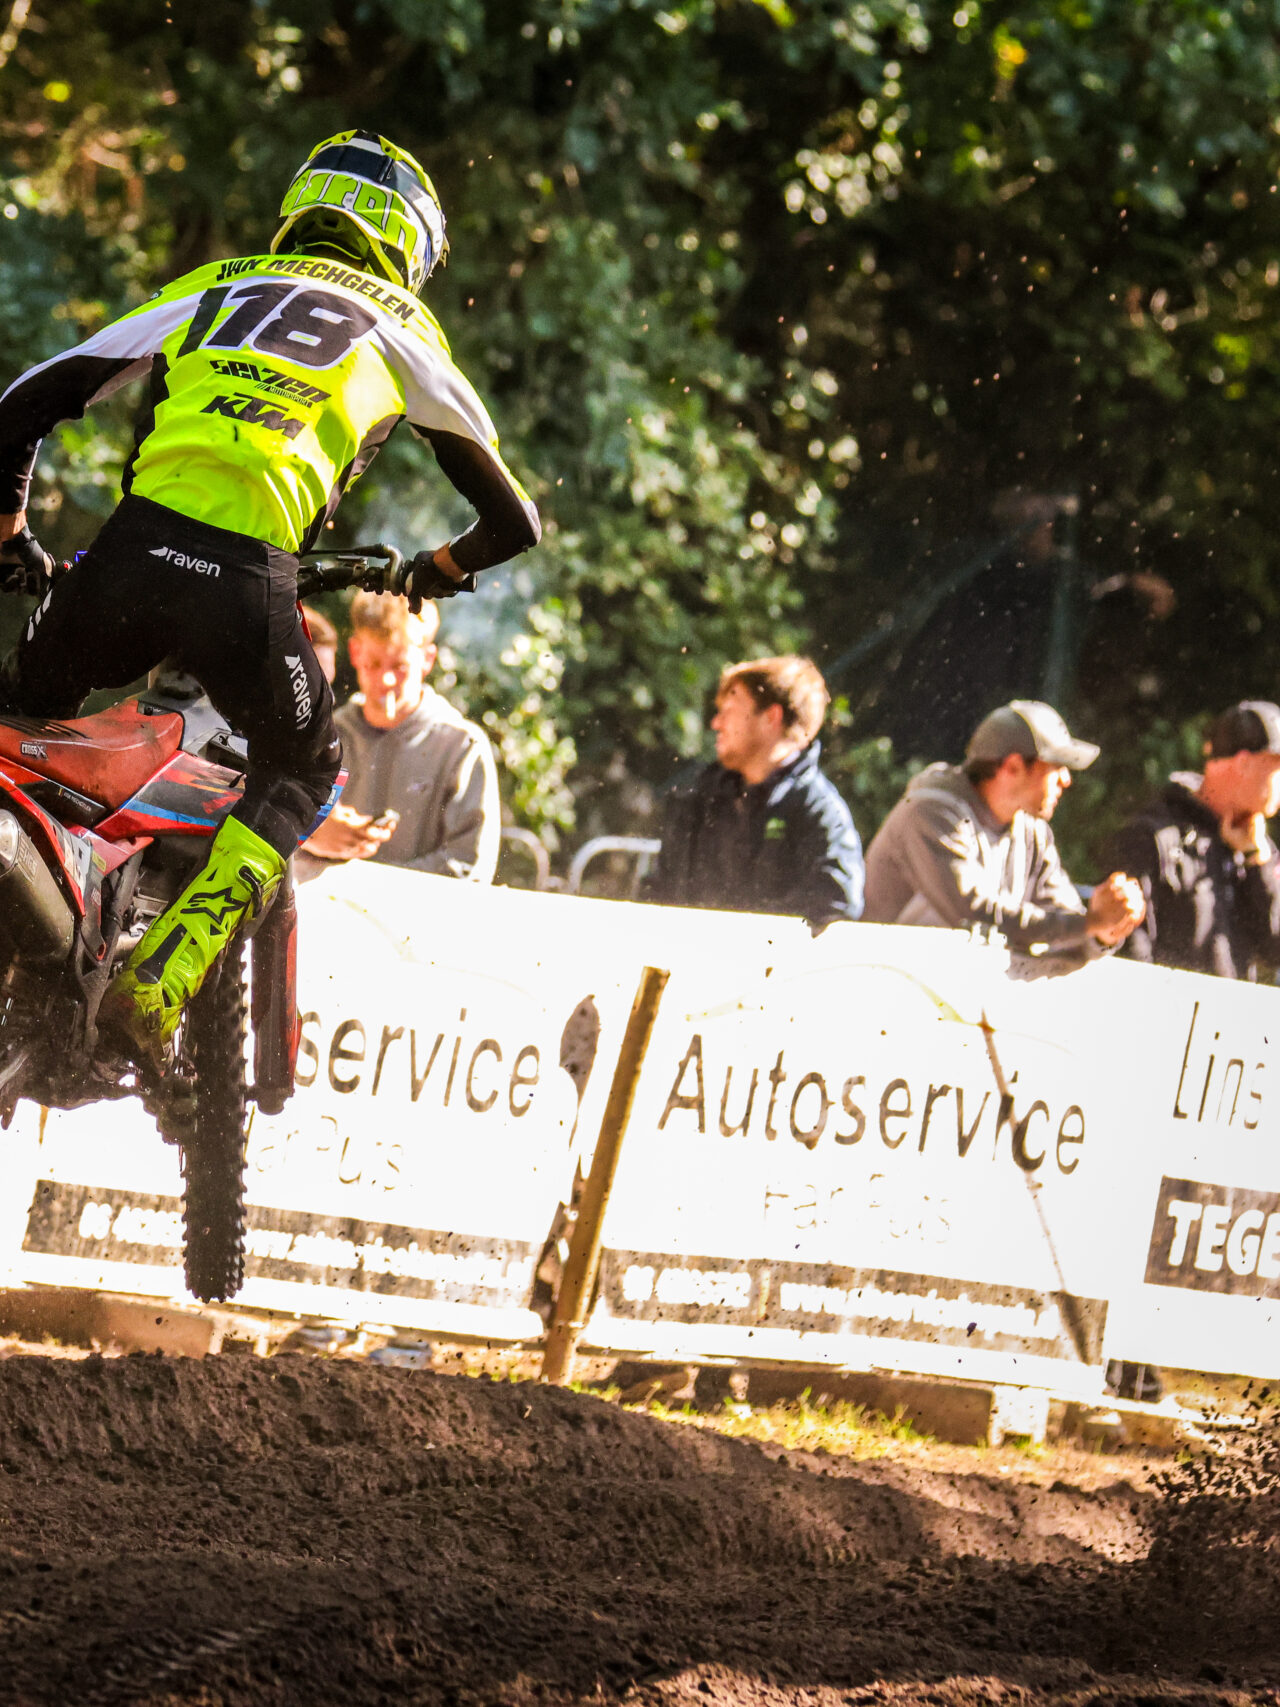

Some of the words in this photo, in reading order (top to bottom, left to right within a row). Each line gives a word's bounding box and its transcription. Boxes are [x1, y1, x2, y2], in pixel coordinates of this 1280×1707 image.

[266, 259, 415, 321] MECHGELEN
[176, 283, 377, 367] 118
[200, 392, 306, 440] KTM
[164, 548, 221, 578] raven
[289, 661, 313, 730] raven
[294, 1007, 540, 1118] service
[657, 1033, 1085, 1175] Autoservice
